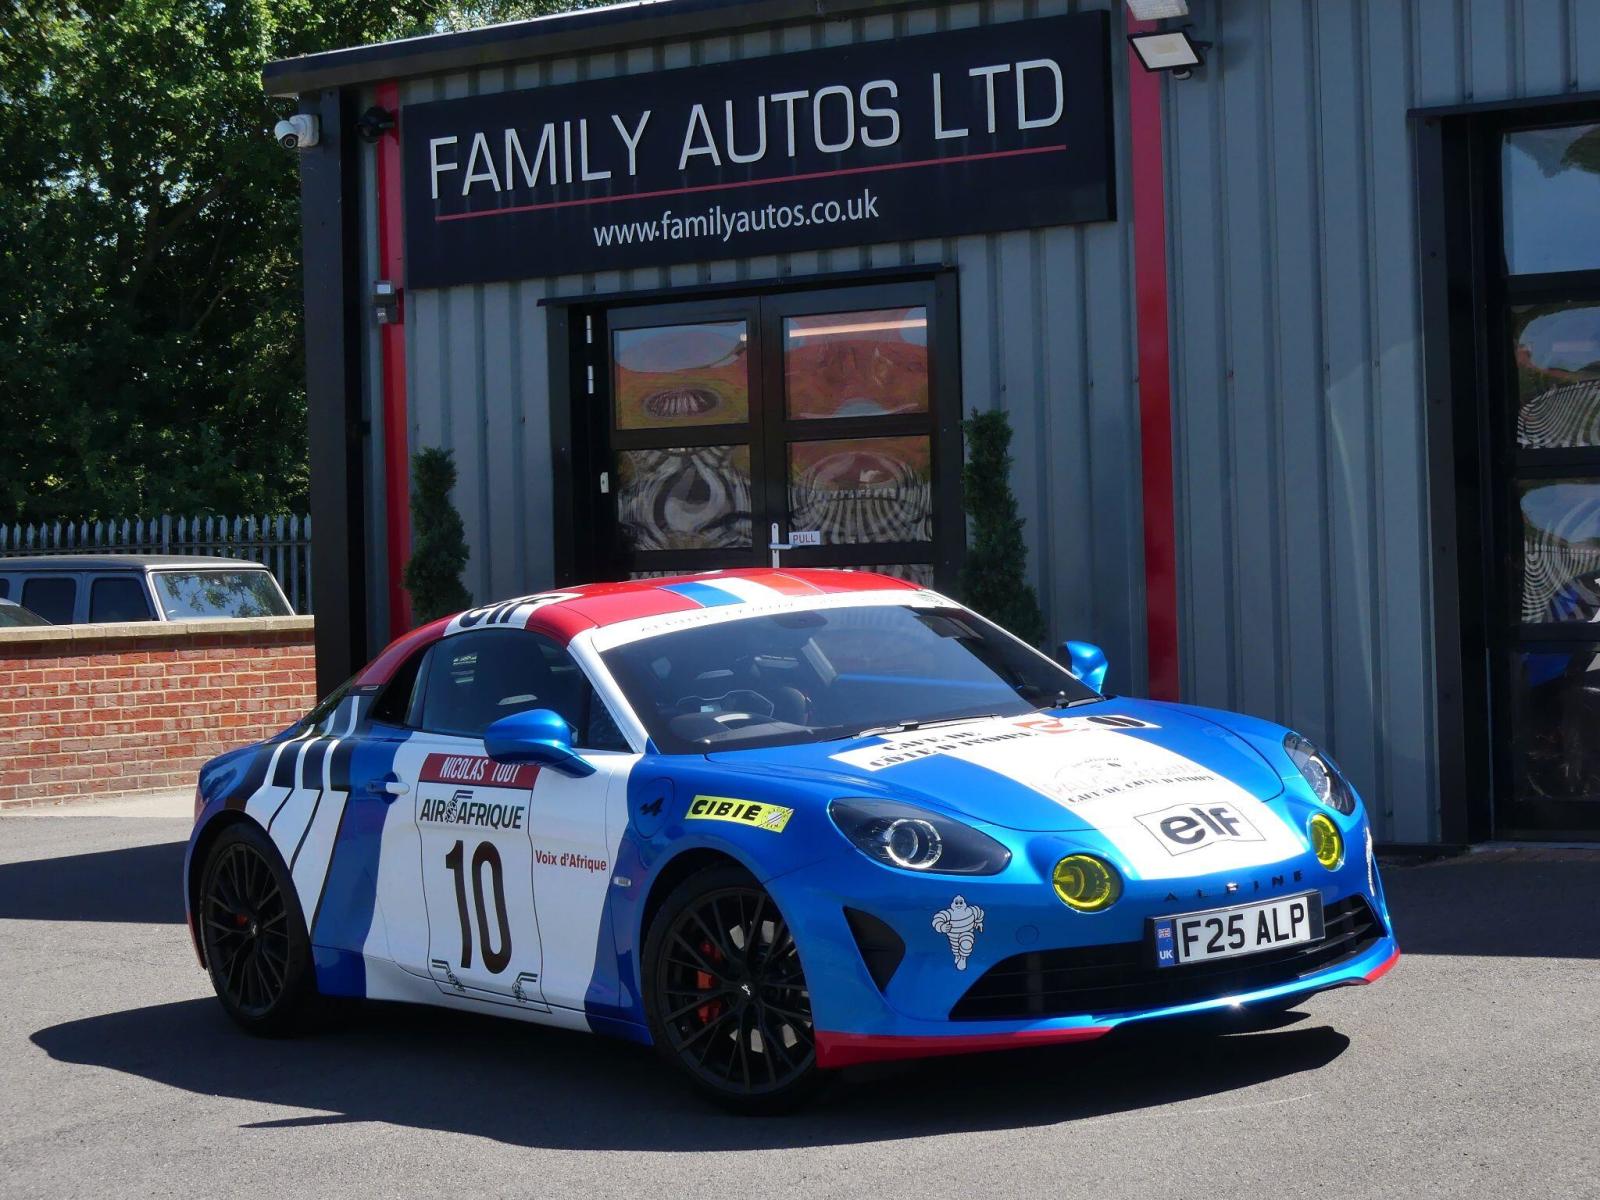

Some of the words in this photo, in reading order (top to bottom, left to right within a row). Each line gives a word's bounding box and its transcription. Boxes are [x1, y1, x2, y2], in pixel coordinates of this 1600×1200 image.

[429, 109, 652, 200] FAMILY
[678, 79, 901, 171] AUTOS
[932, 57, 1066, 142] LTD
[593, 188, 880, 248] www.familyautos.co.uk
[792, 534, 817, 544] PULL
[440, 757, 488, 780] NICOLAS
[419, 798, 446, 822] AIR
[455, 801, 525, 830] AFRIQUE
[691, 799, 762, 821] CIBIE
[1160, 807, 1240, 844] elf
[535, 849, 557, 865] Voix
[560, 852, 607, 873] d'Afrique
[1165, 870, 1304, 901] ALPINE
[445, 839, 513, 974] 10
[1181, 912, 1246, 957] F25
[1256, 902, 1304, 945] ALP
[1159, 949, 1174, 960] UK
